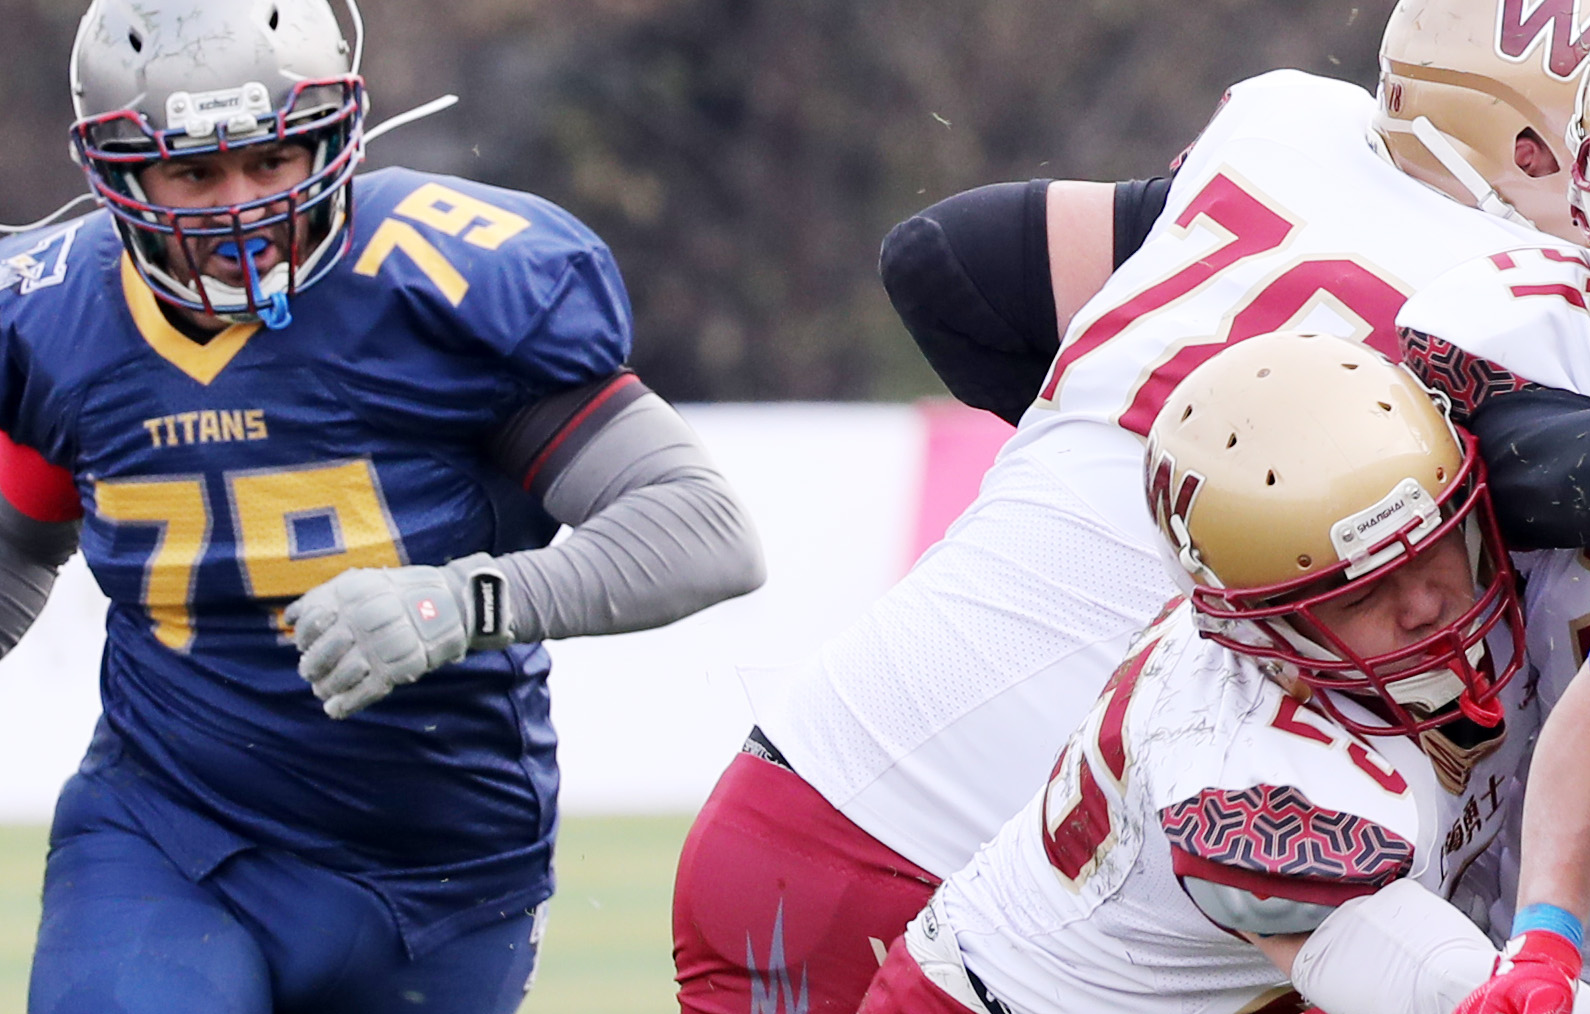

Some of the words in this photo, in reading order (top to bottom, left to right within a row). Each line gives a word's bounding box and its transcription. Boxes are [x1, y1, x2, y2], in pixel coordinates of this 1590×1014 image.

[354, 182, 532, 307] 79
[143, 409, 269, 448] TITANS
[1357, 500, 1405, 533] SHANGHAI
